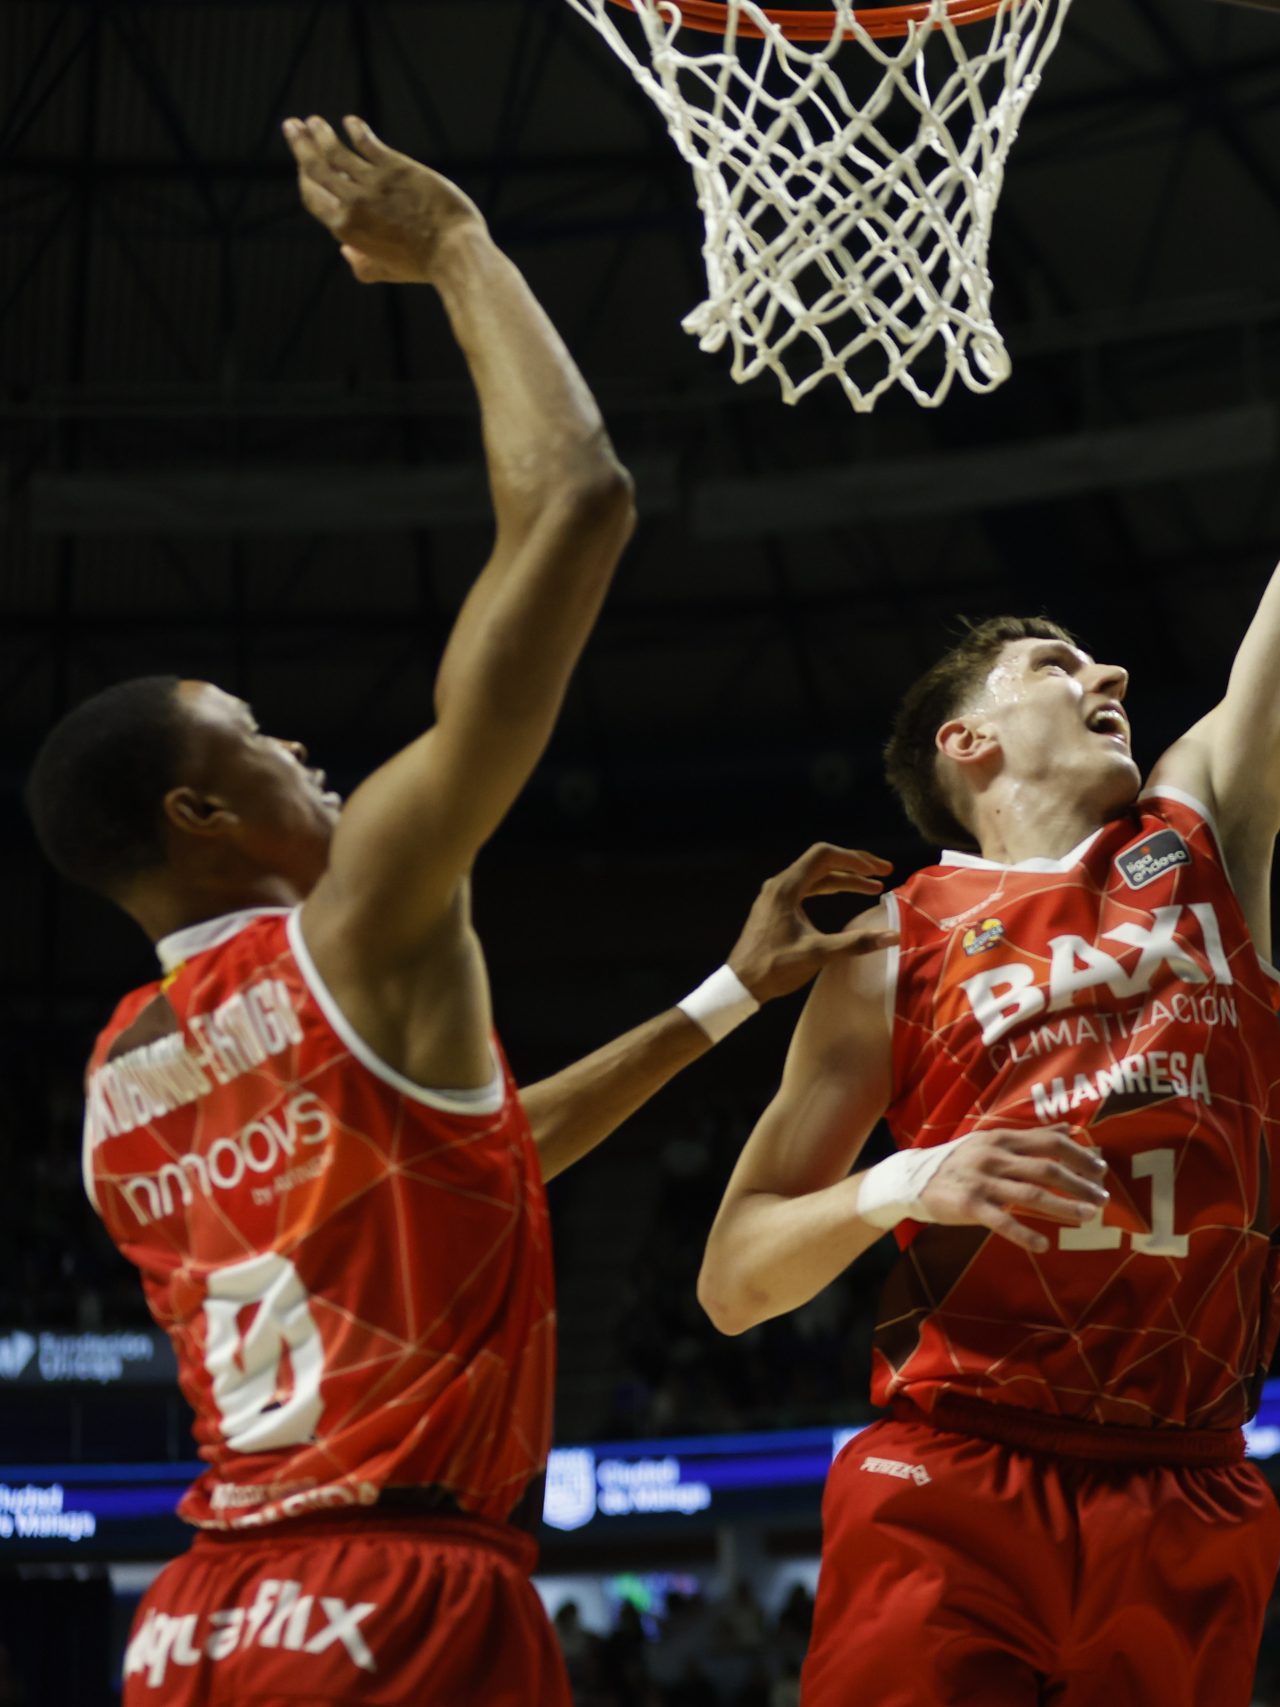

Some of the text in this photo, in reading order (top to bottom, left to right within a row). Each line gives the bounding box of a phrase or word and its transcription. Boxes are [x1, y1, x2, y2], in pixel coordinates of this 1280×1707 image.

[960, 902, 1233, 1046] BAXI
[988, 989, 1238, 1073] CLIMATIZACIÓN
[1030, 1051, 1212, 1122] MANRESA
